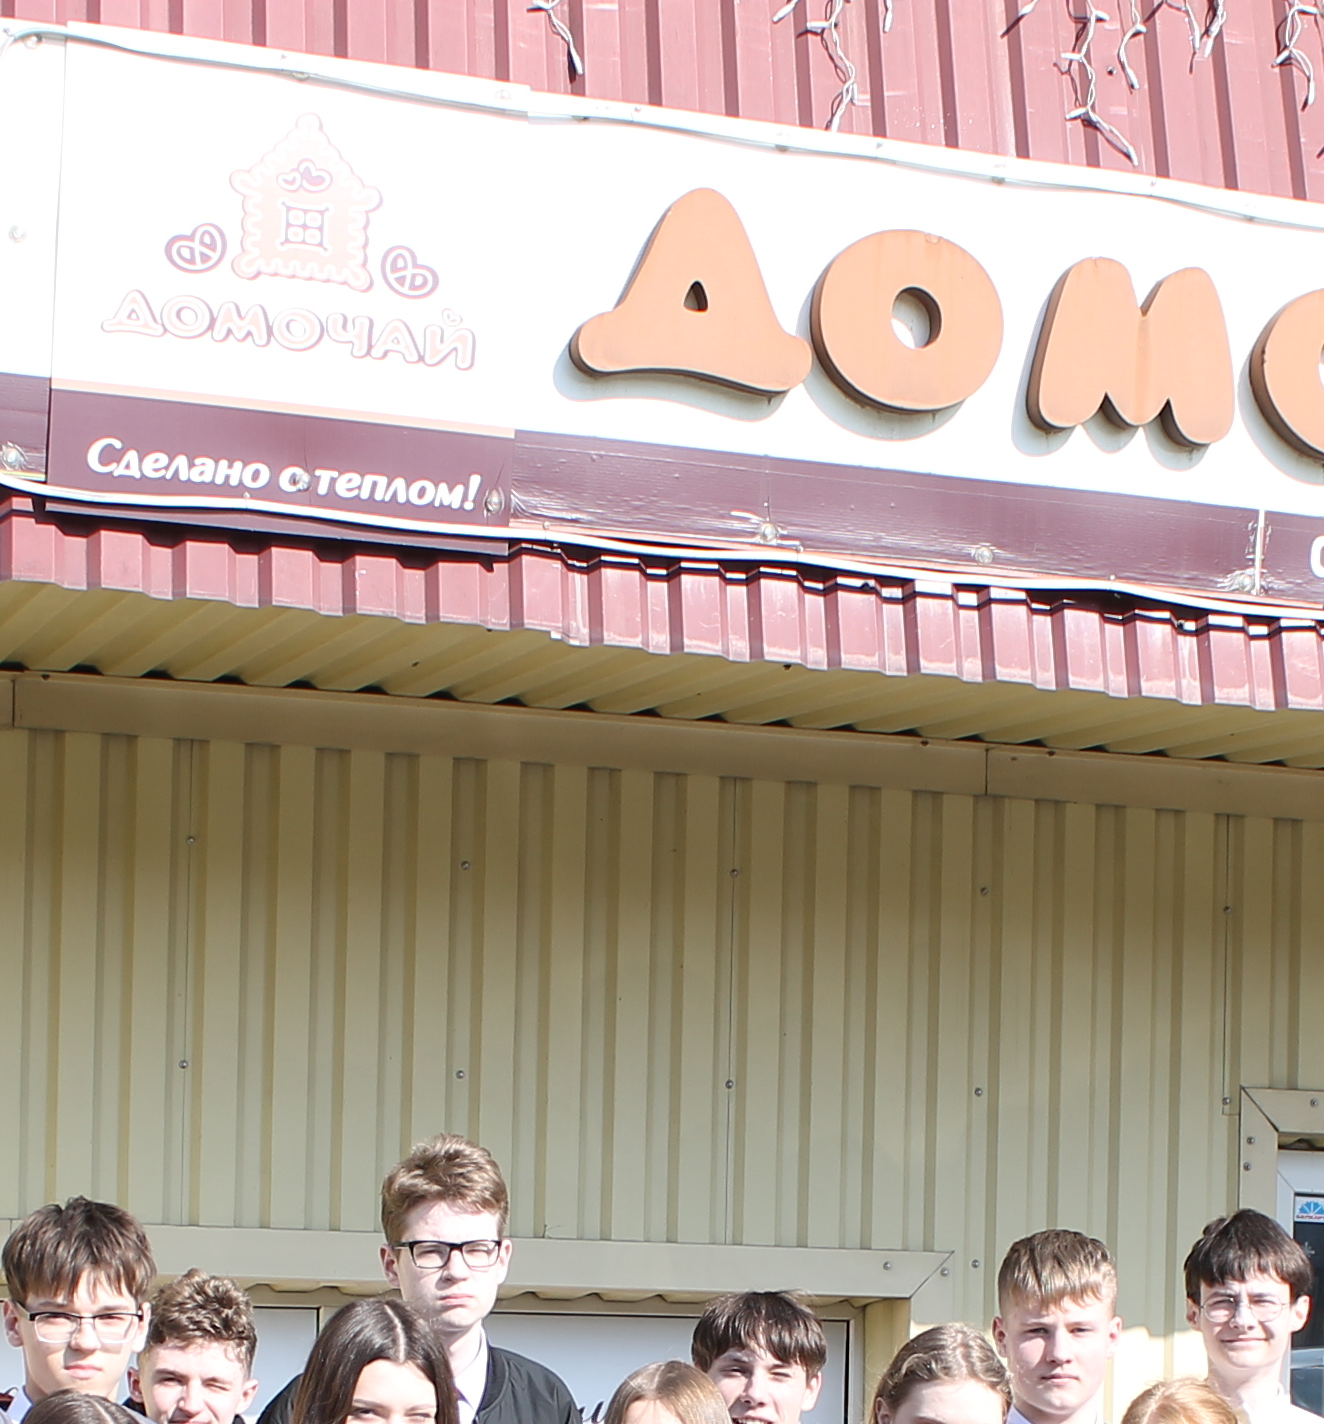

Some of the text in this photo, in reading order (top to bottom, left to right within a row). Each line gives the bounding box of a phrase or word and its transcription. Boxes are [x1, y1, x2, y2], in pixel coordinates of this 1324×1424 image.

[101, 289, 476, 371] ДОМОЧАЙ
[87, 437, 483, 511] Сделано с теплом!
